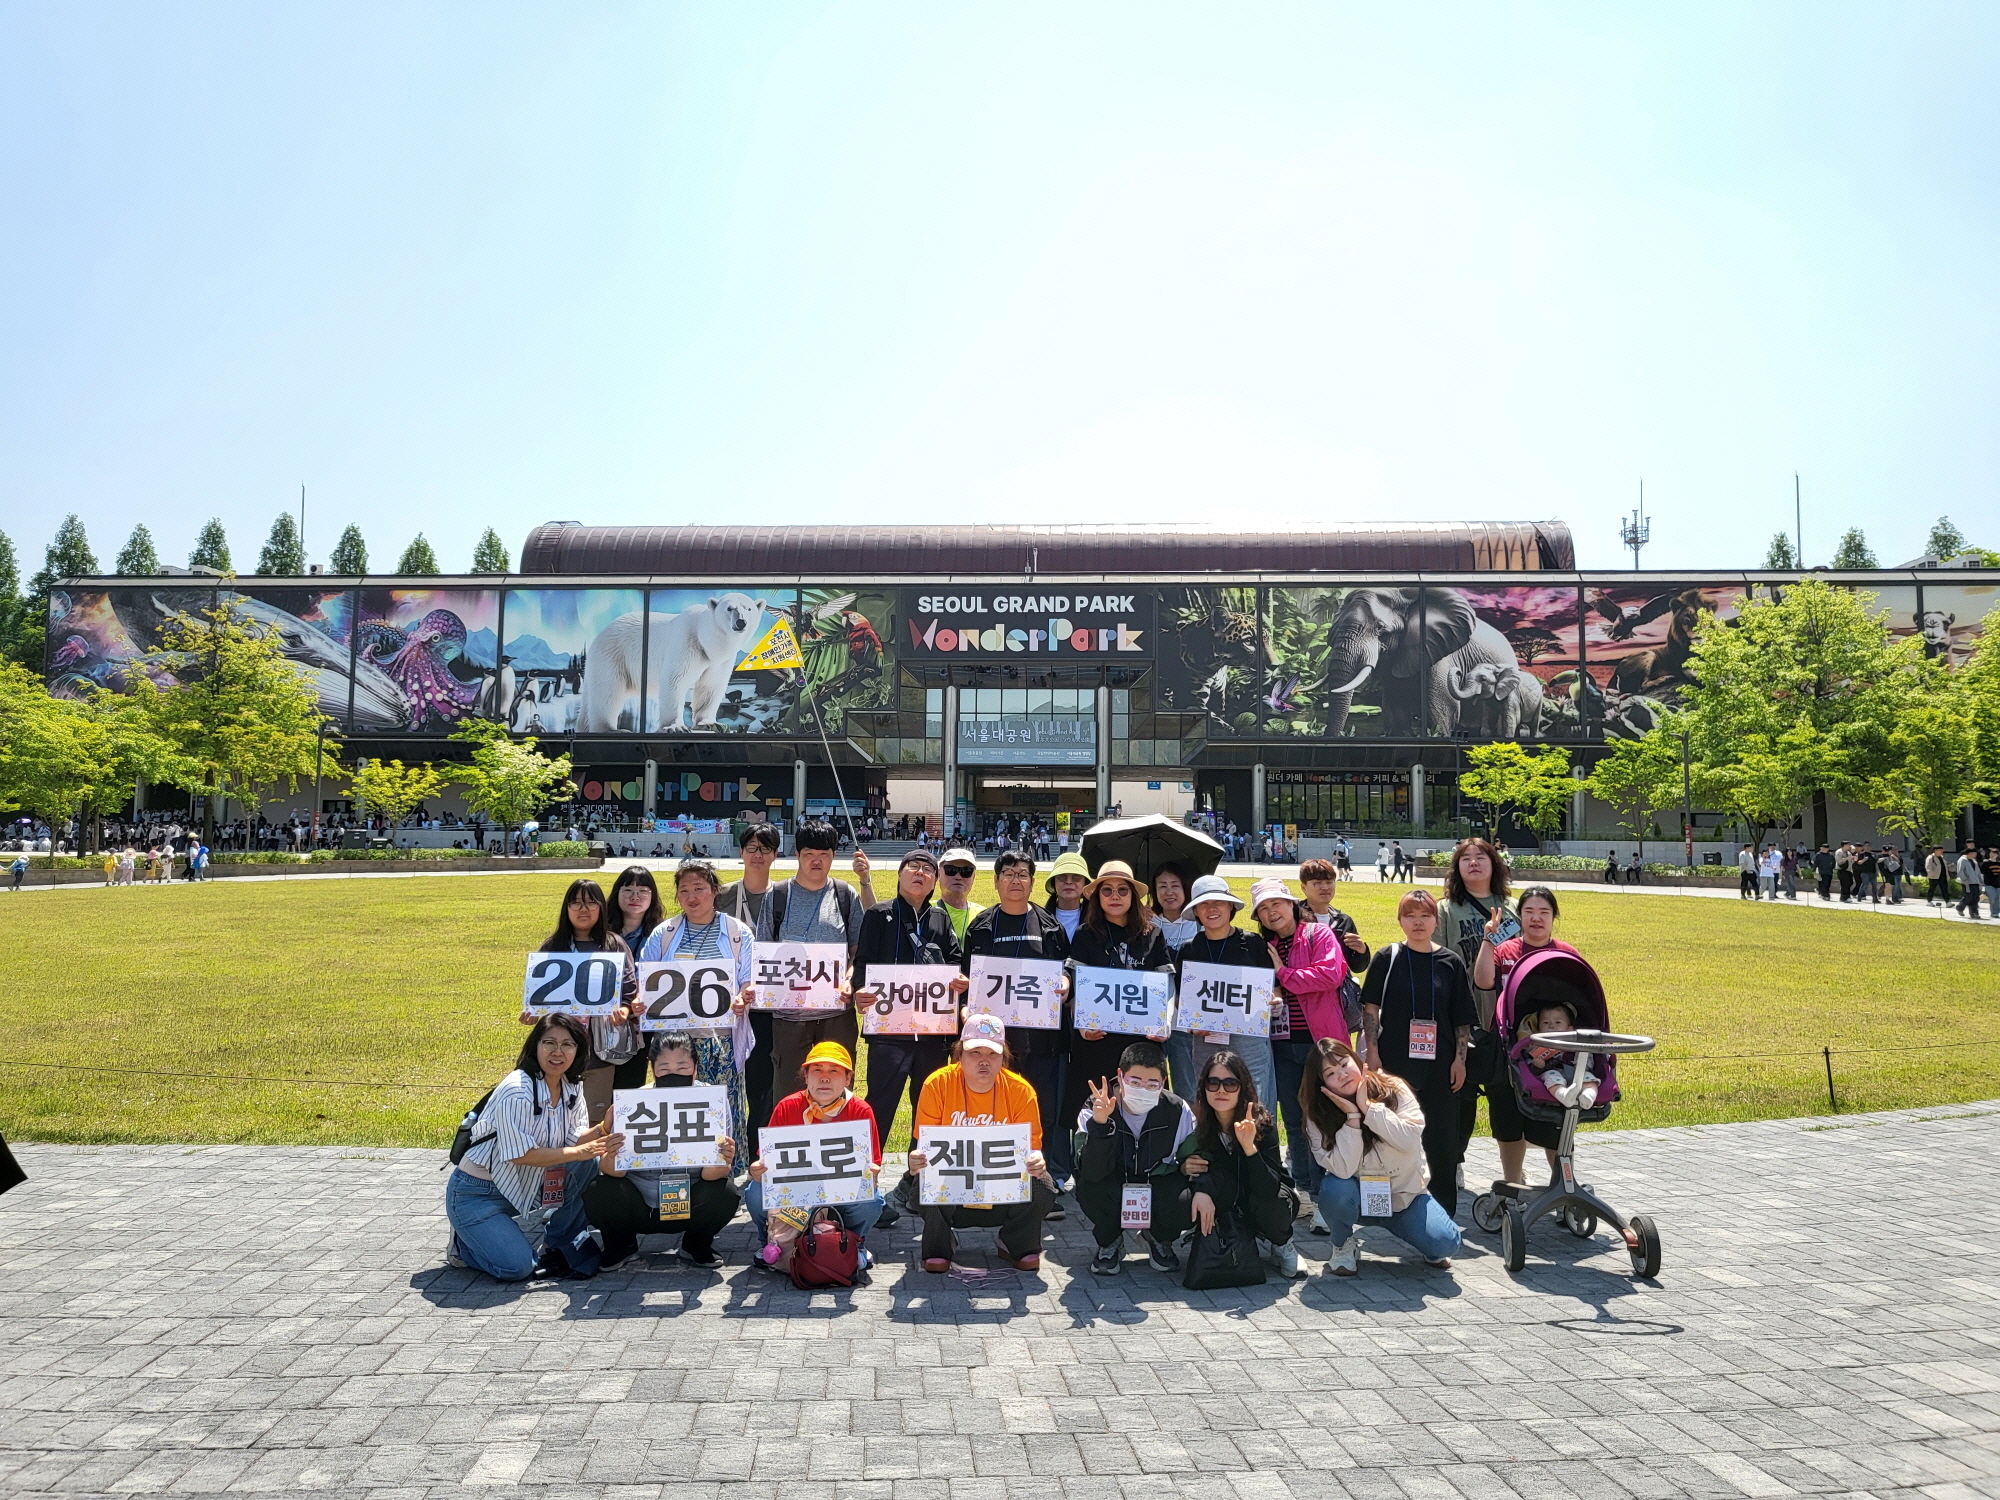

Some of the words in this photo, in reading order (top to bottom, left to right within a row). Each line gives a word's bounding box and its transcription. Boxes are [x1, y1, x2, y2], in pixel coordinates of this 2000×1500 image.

[918, 596, 988, 613] SEOUL
[993, 596, 1070, 613] GRAND
[1075, 595, 1135, 612] PARK
[770, 631, 790, 646] 포천시
[761, 640, 793, 660] 장애인가족
[964, 728, 1031, 743] 서울대공원
[1267, 773, 1284, 783] 원더
[1286, 772, 1303, 783] 카페
[1305, 773, 1341, 783] Wonder
[1344, 772, 1371, 783] Cafe
[1372, 772, 1390, 784] 커피
[1392, 774, 1399, 783] &
[1401, 772, 1435, 784] 베리
[571, 772, 762, 802] ondrPark
[529, 957, 619, 1006] 20
[644, 967, 732, 1021] 26
[756, 957, 842, 991] 포천시
[868, 981, 957, 1017] 장애인
[987, 974, 1043, 1010] 가족
[1094, 982, 1149, 1015] 지원
[1196, 978, 1252, 1016] 센터
[1411, 1043, 1434, 1052] 이효정
[624, 1101, 715, 1153] 쉼표
[772, 1136, 864, 1184] 프로
[928, 1139, 1021, 1190] 젝트
[660, 1202, 689, 1213] 고영미
[1122, 1211, 1149, 1221] 양태인
